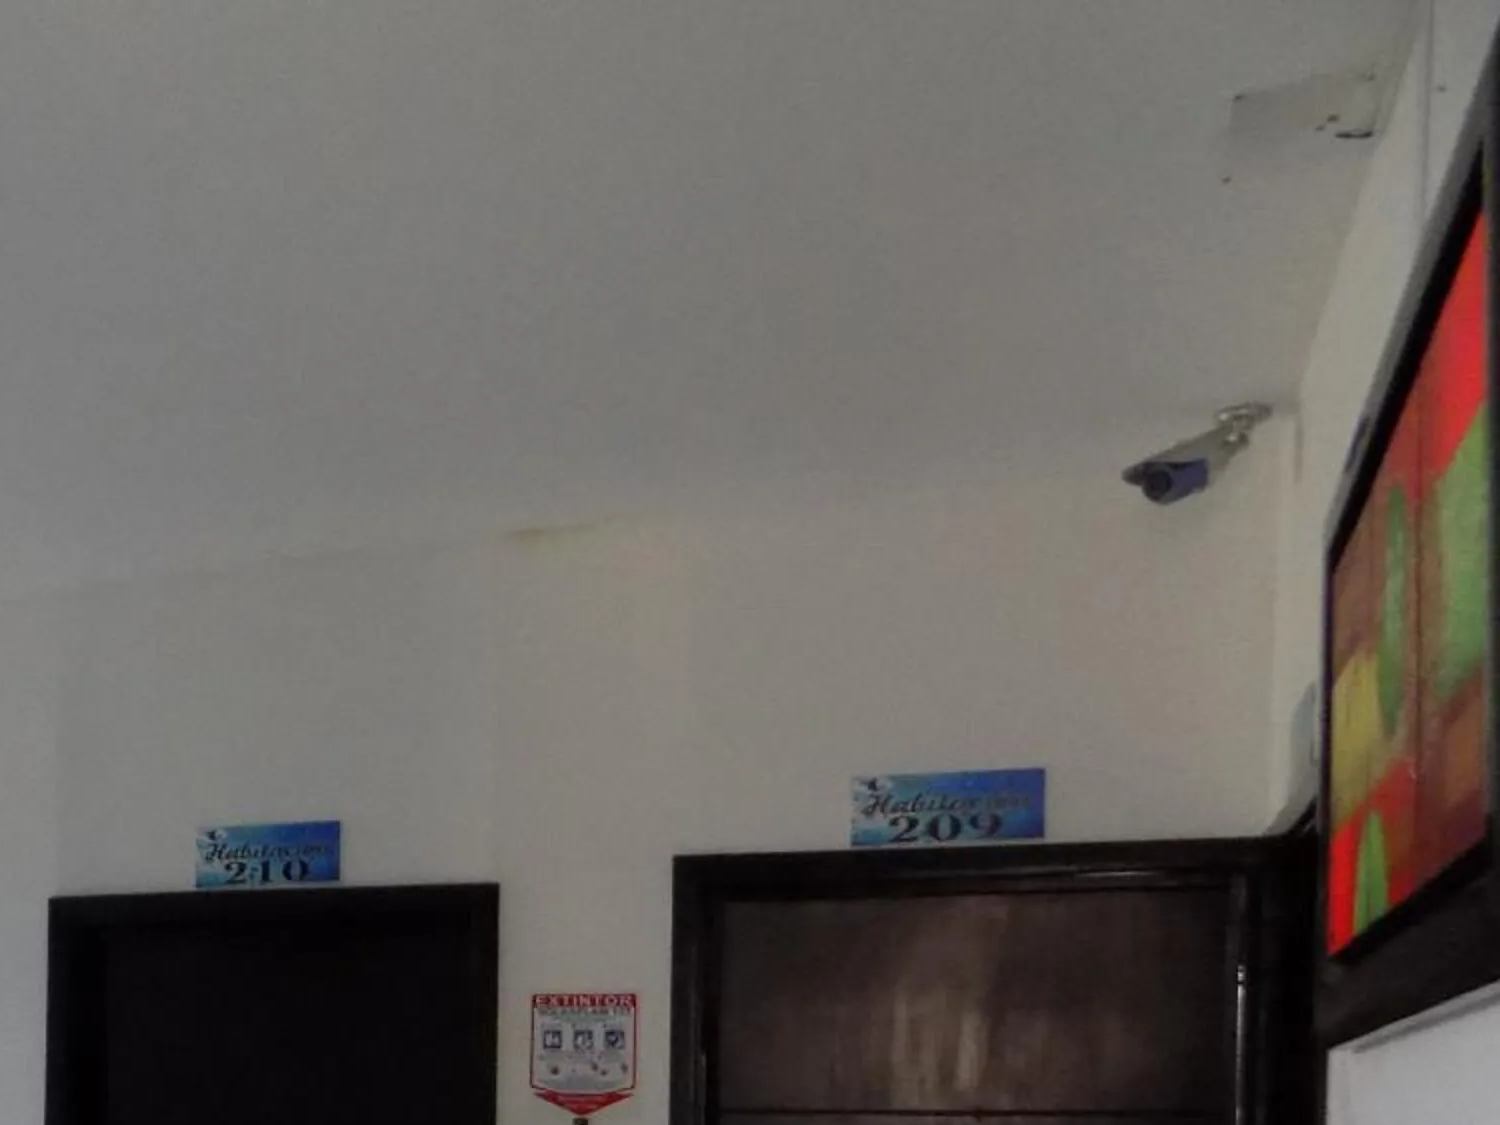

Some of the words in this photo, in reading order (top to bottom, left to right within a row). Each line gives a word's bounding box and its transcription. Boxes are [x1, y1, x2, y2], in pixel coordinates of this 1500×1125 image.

[887, 812, 1004, 843] 209
[224, 860, 310, 885] 210
[535, 994, 633, 1007] EXTINTOR
